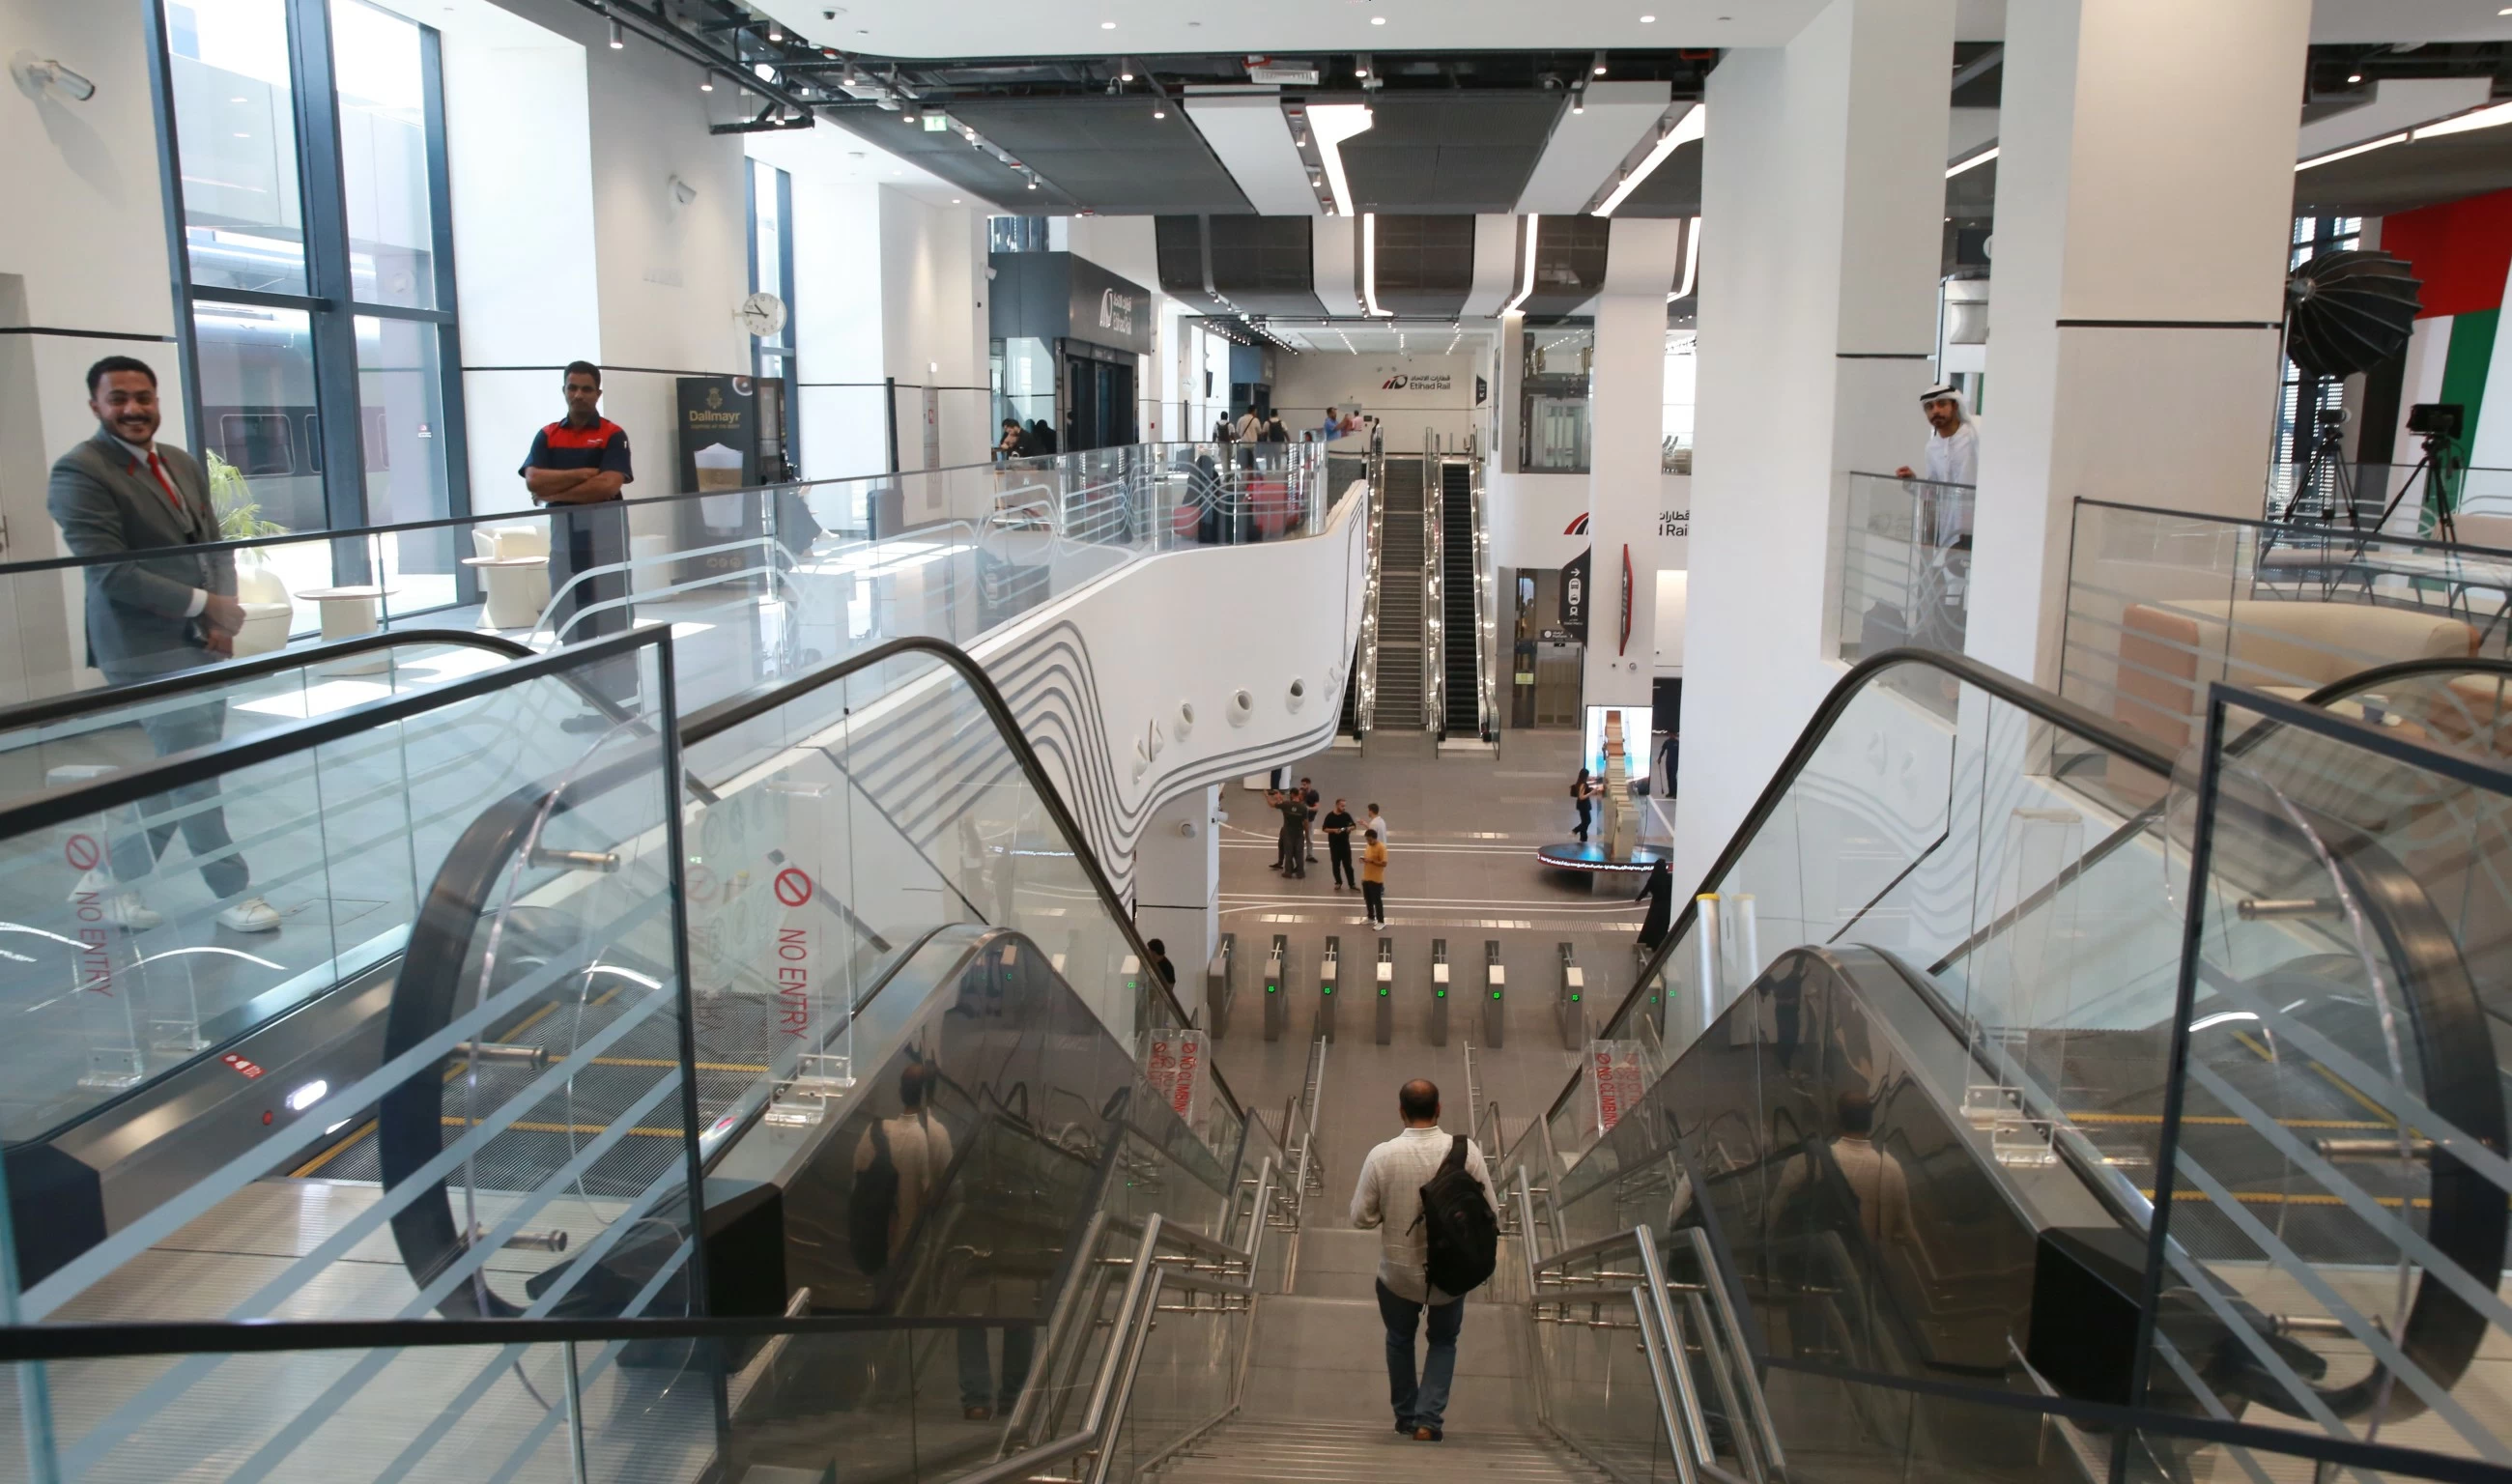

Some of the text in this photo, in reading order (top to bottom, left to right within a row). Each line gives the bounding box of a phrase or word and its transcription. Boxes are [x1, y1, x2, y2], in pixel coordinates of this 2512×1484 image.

[1410, 382, 1451, 390] Etihad Rail
[689, 410, 741, 424] Dallmayr
[1666, 524, 1688, 537] Rai
[74, 892, 113, 998] NO ENTRY
[778, 928, 808, 1041] NO ENTRY
[1180, 1056, 1194, 1070] NO
[1598, 1067, 1613, 1081] NO
